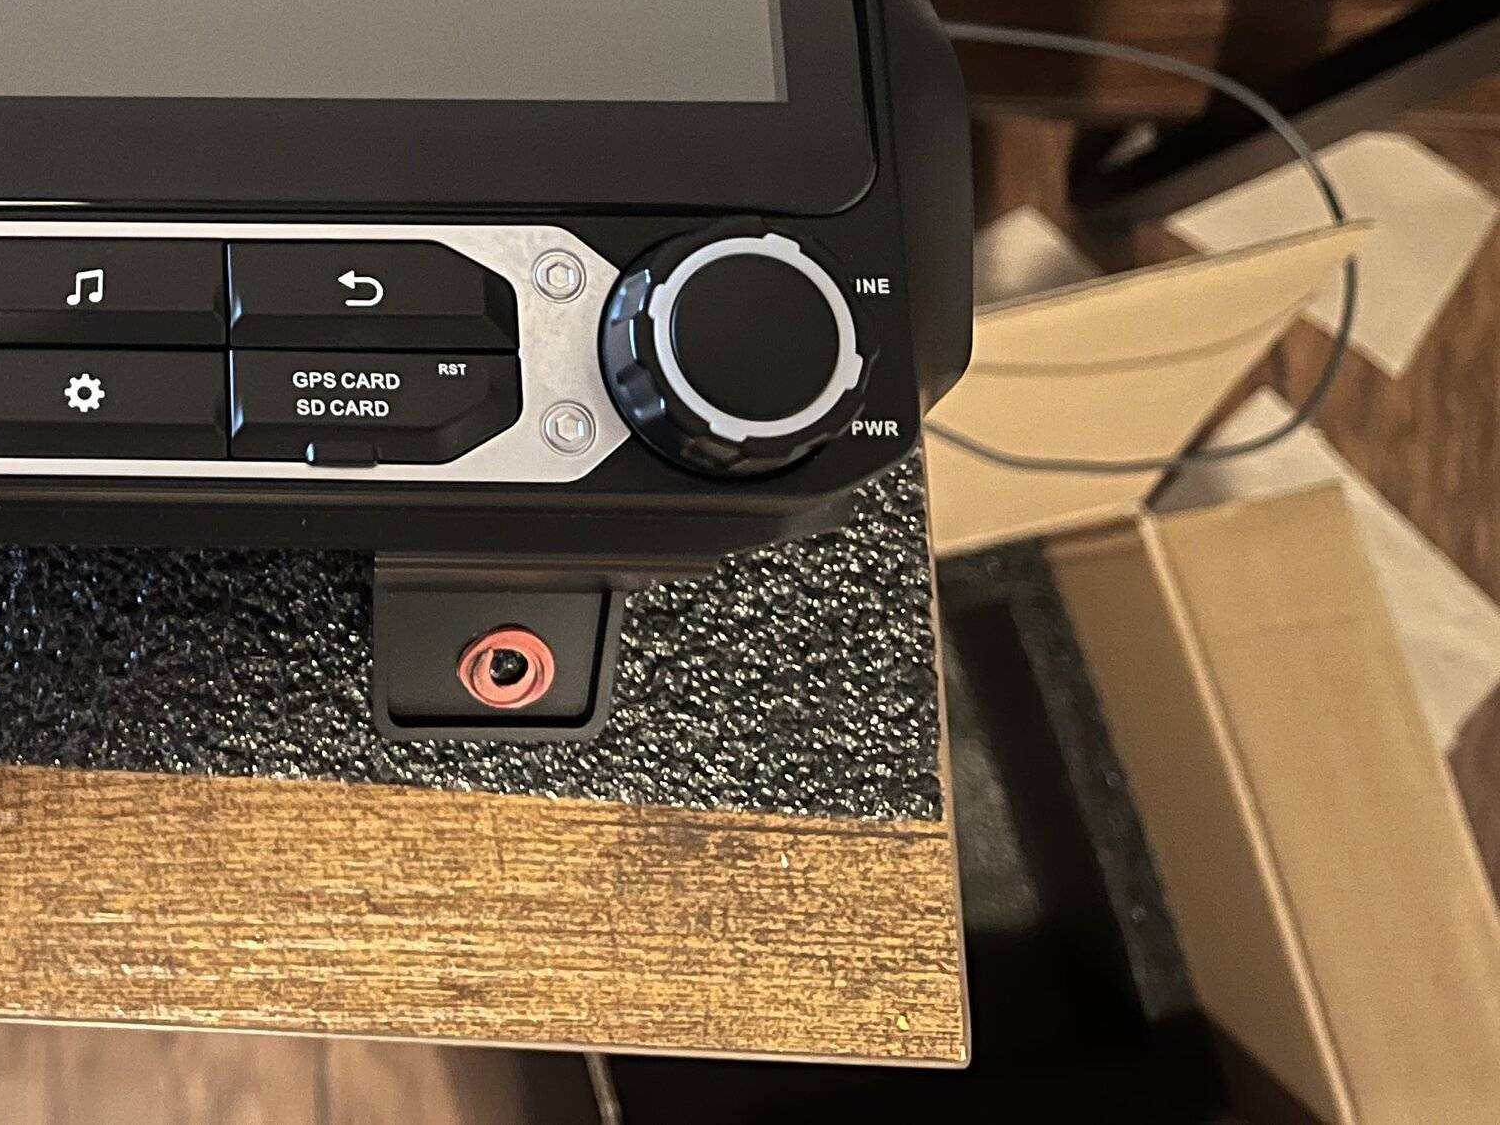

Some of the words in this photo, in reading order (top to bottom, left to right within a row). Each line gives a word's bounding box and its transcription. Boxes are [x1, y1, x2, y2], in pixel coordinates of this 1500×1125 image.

[437, 362, 468, 377] RST
[292, 371, 338, 390] GPS
[340, 372, 401, 391] CARD
[296, 398, 326, 416] SD
[329, 399, 390, 418] CARD
[851, 419, 900, 437] PWR
